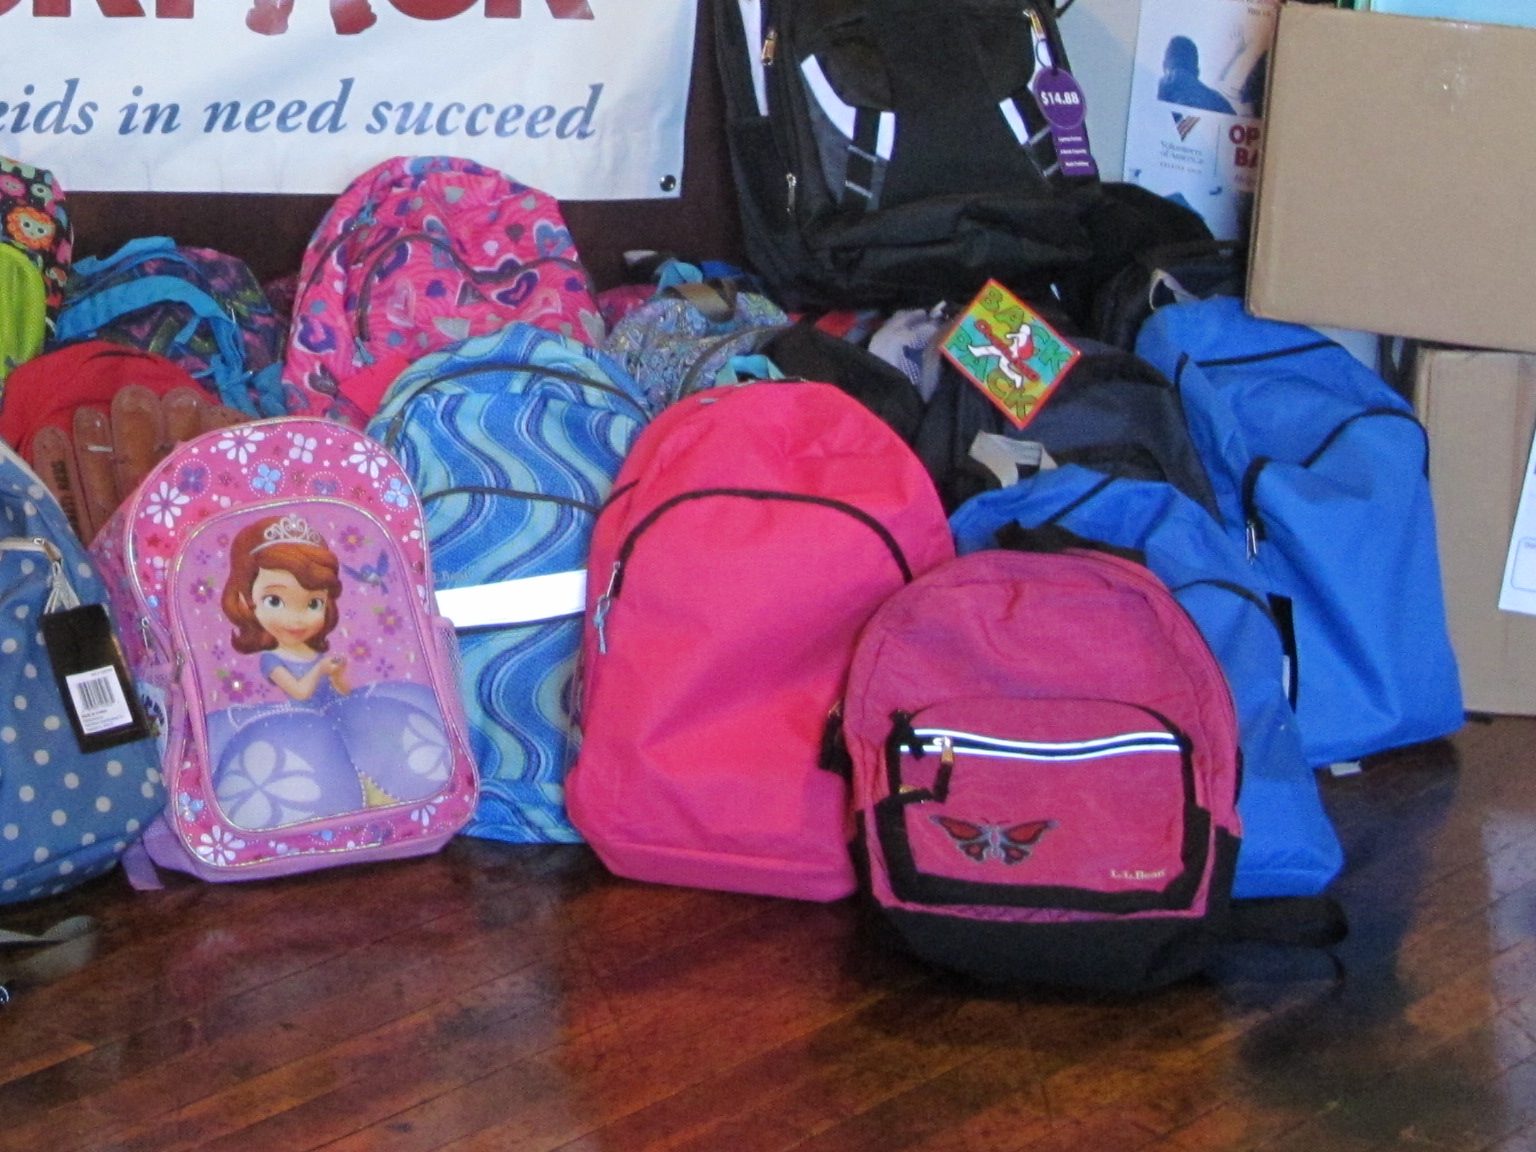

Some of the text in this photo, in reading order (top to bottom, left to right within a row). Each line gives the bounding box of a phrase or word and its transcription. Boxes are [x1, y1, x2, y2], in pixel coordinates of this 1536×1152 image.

[119, 86, 181, 135] in
[203, 78, 355, 135] need
[366, 83, 604, 140] succeed
[1040, 91, 1080, 106] $14.88
